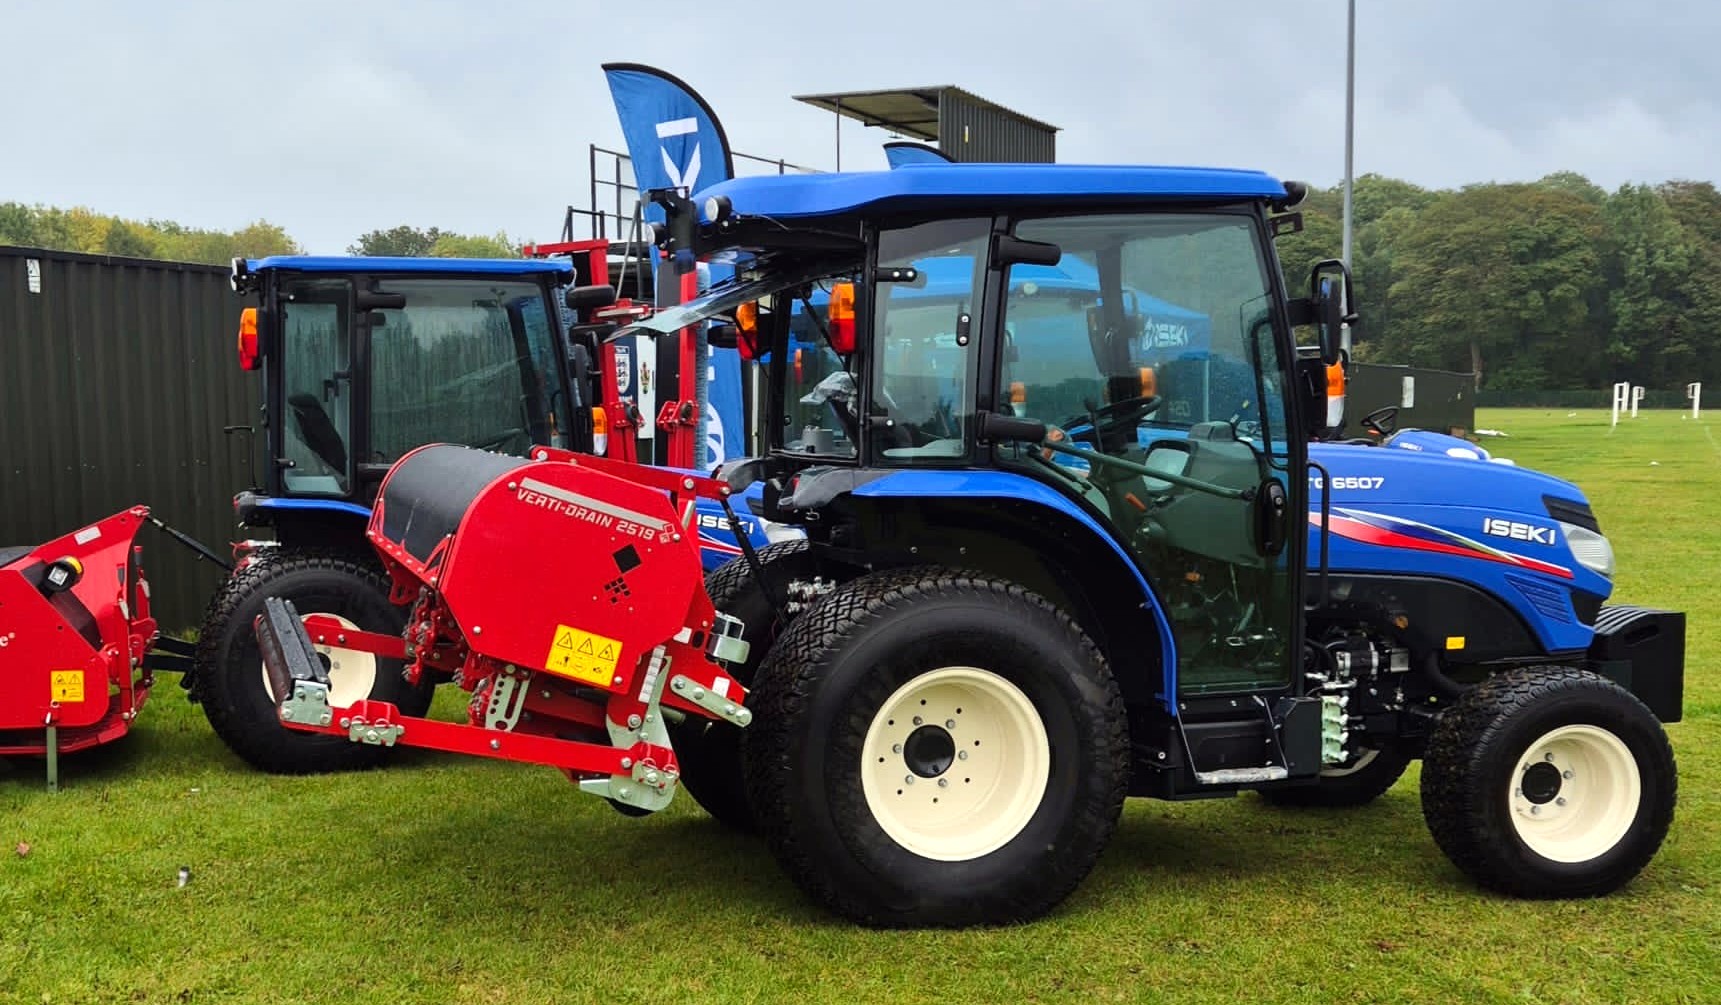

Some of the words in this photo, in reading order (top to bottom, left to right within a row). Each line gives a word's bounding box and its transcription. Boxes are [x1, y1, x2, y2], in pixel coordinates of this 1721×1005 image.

[1332, 477, 1384, 489] 6507
[516, 488, 613, 528] VERTI-DRAIN
[616, 520, 656, 540] 2519
[1483, 517, 1556, 545] ISEKI
